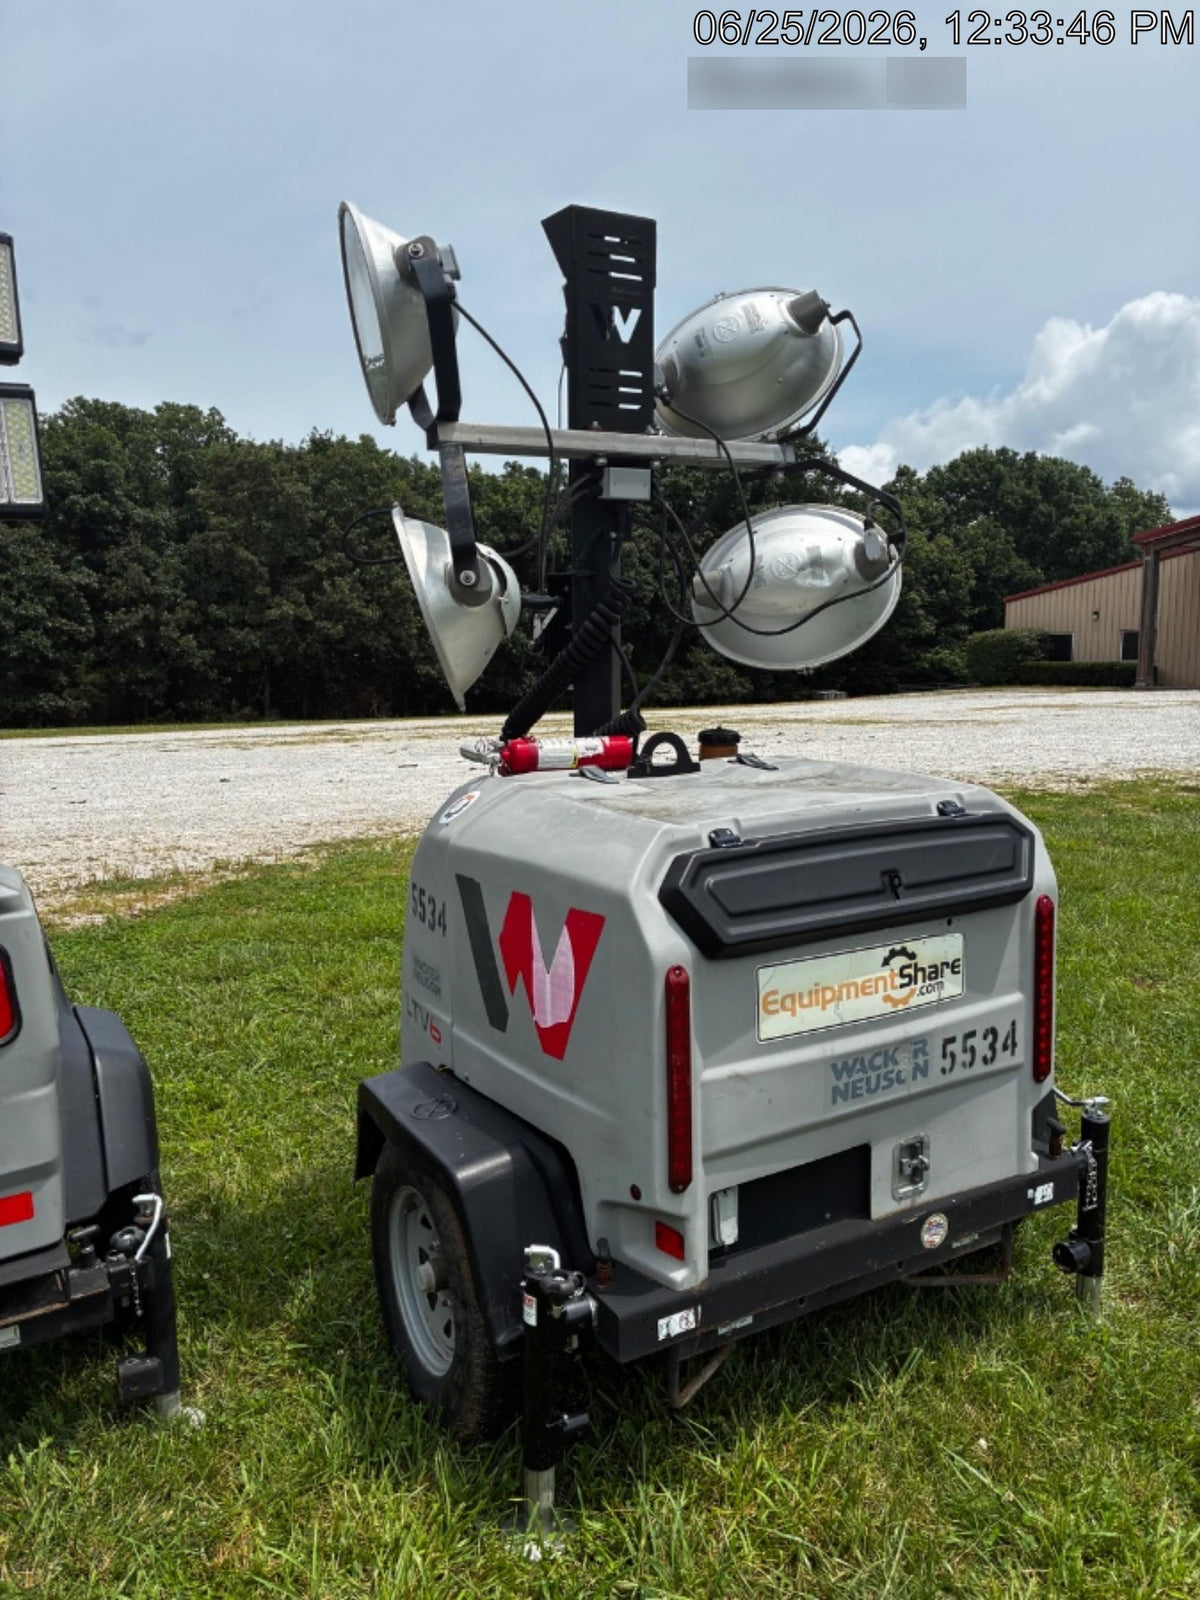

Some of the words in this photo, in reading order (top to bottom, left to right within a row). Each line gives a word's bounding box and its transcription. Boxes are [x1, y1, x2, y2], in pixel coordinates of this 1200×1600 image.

[411, 882, 447, 937] 5534
[761, 957, 961, 1018] EquipmentShare
[830, 1038, 929, 1082] WACKR
[940, 1019, 1018, 1076] 5534
